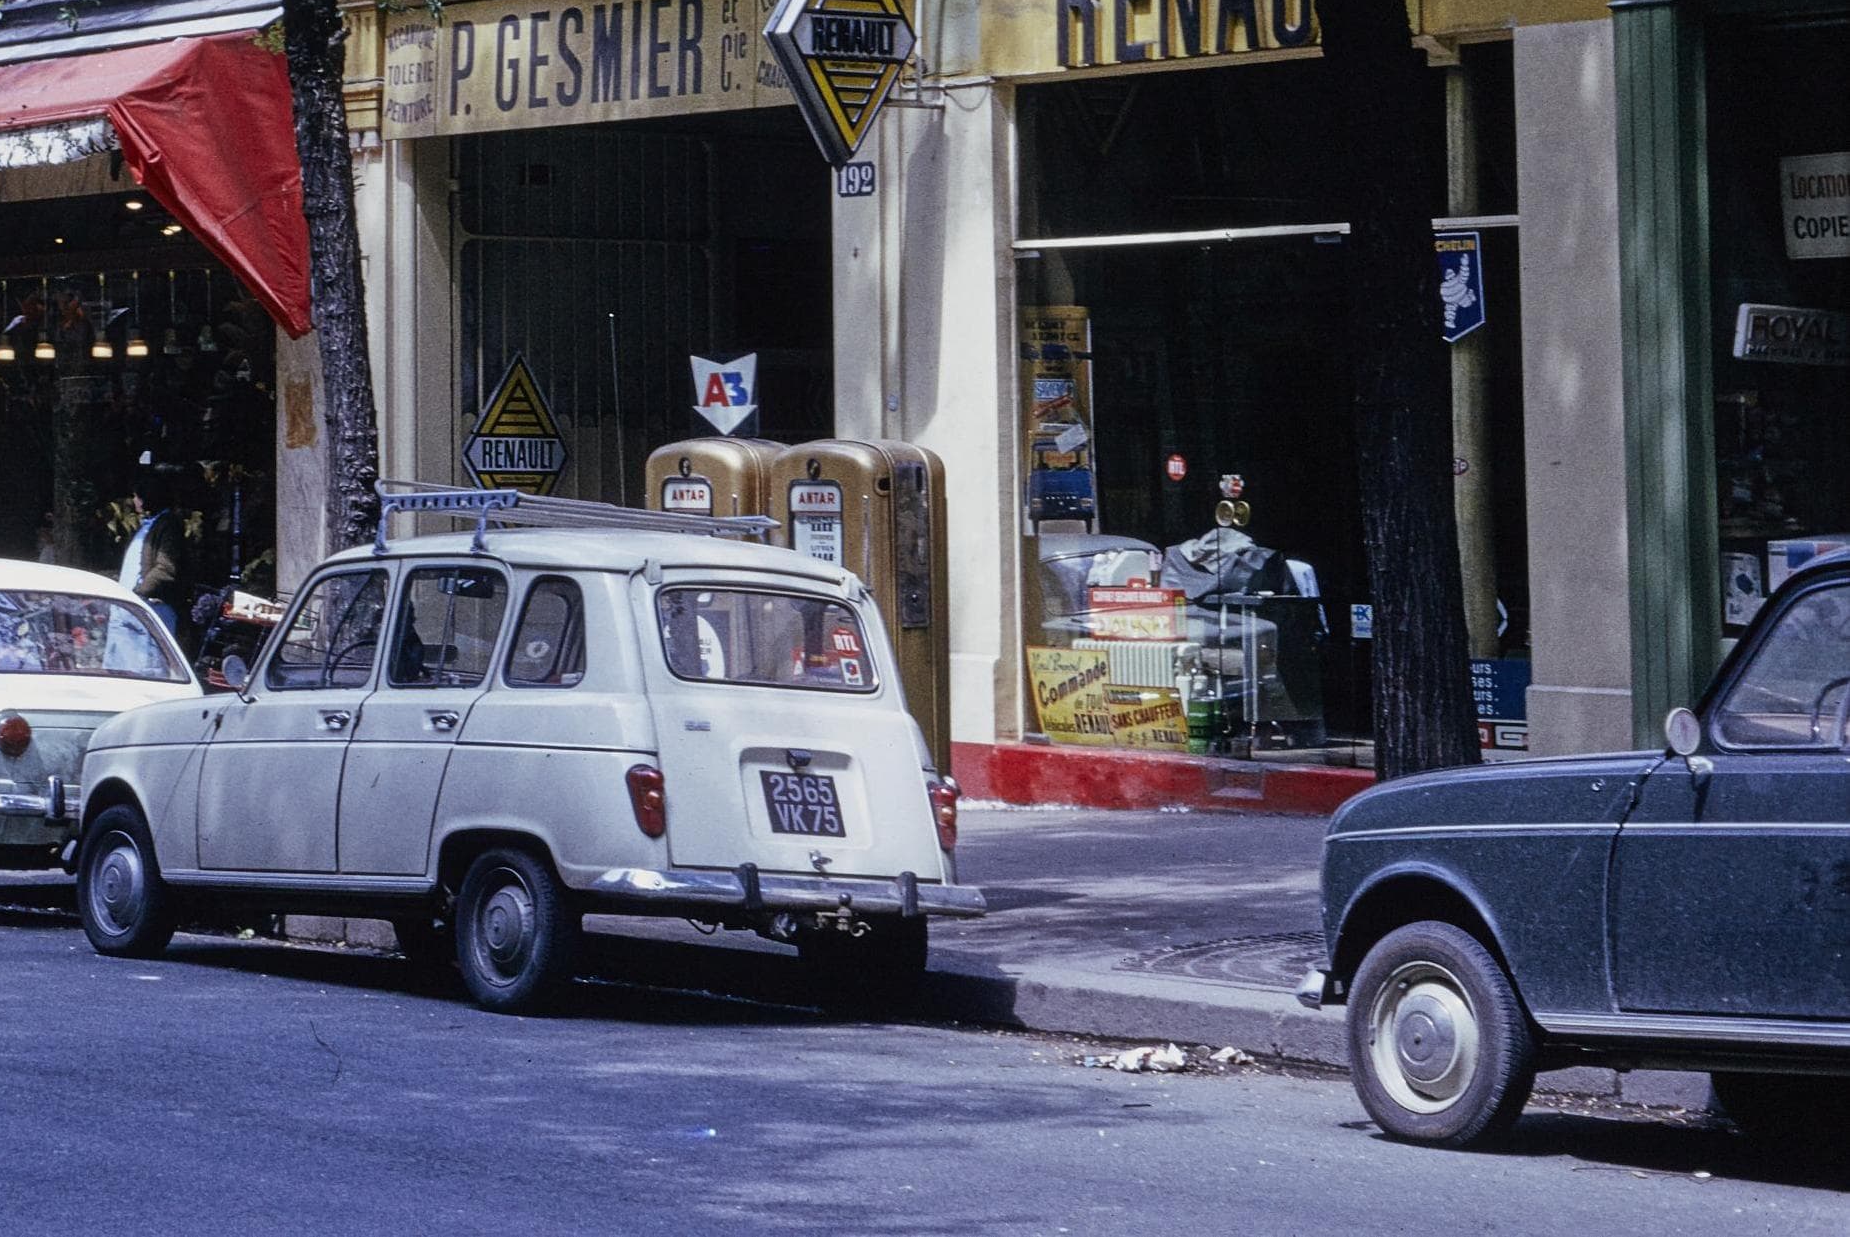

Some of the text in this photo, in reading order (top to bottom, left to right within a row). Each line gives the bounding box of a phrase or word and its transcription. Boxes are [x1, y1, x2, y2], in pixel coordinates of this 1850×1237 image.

[811, 16, 897, 56] RENAULT
[389, 61, 434, 85] TOLERIE
[839, 165, 872, 194] 192
[1435, 240, 1476, 252] CHELIN
[703, 371, 748, 407] A3
[482, 439, 557, 469] RENAULT
[672, 490, 704, 501] ANTAR
[799, 492, 836, 504] ANTAR
[833, 634, 860, 652] RTL
[1038, 661, 1107, 707] Commande
[1074, 714, 1114, 735] RENAUL
[769, 773, 833, 805] 2565
[774, 804, 840, 833] VK 75
